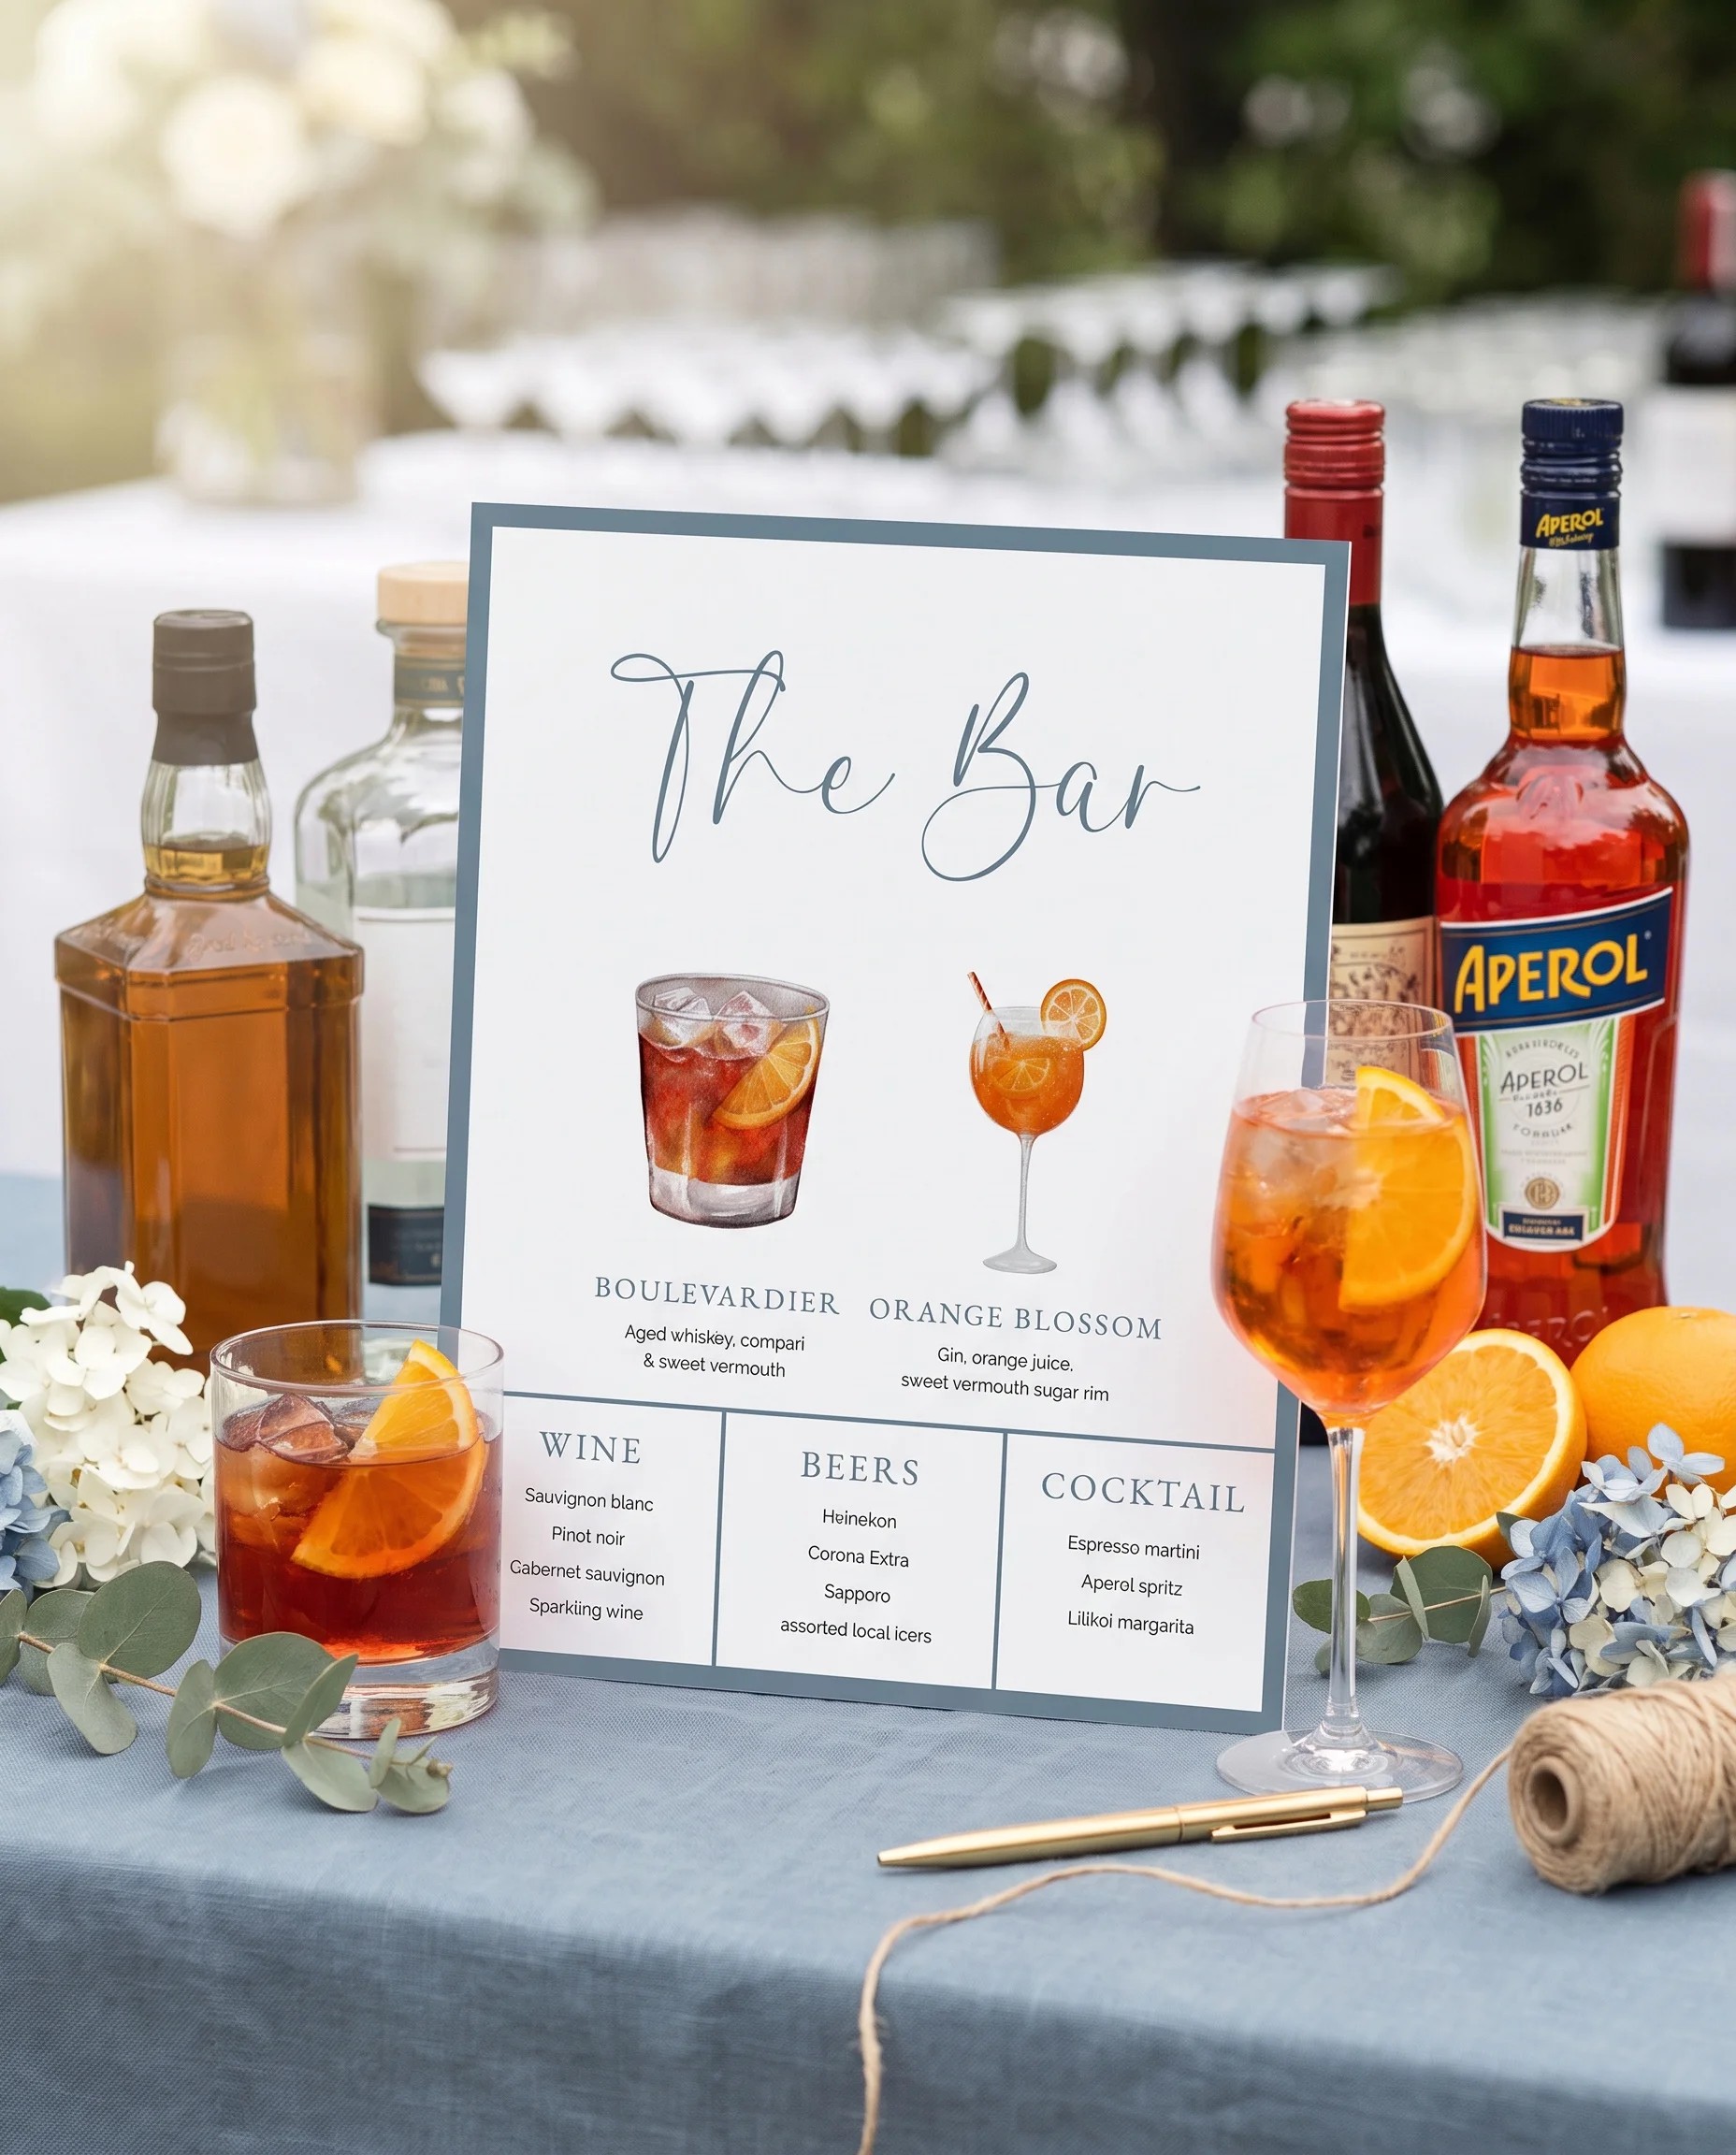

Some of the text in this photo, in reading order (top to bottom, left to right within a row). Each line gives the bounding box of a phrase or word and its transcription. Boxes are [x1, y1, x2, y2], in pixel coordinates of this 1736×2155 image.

[1536, 508, 1604, 538] APEROL
[611, 650, 1200, 881] The Bar
[1454, 933, 1648, 1014] APEROL
[1500, 1062, 1589, 1094] APEROL
[595, 1277, 840, 1314] BOULEVARDIER
[870, 1298, 1161, 1339] ORANGE BLOSSOM
[625, 1324, 804, 1353] Aged whiskey, compari
[644, 1352, 785, 1377] & sweet vermouth
[938, 1347, 966, 1365] Gin,
[972, 1353, 1028, 1370] orange
[902, 1375, 1108, 1402] sweet vermouth sugar rim
[540, 1431, 640, 1464] WINE
[801, 1452, 918, 1485] BEERS
[525, 1488, 653, 1511] Sauvignon blanc
[1042, 1473, 1244, 1512] COCKTAIL
[553, 1526, 625, 1545] Pinot noir
[1069, 1535, 1199, 1559] Espresso martini
[808, 1545, 908, 1568] Corona Extra
[586, 1569, 664, 1587] sauvignon
[1081, 1574, 1182, 1598] Aperol spritz
[825, 1584, 890, 1604] Sapporo
[606, 1604, 644, 1620] wine
[1069, 1611, 1194, 1636] Lilikoi margarita
[781, 1621, 932, 1643] assorted local icers
